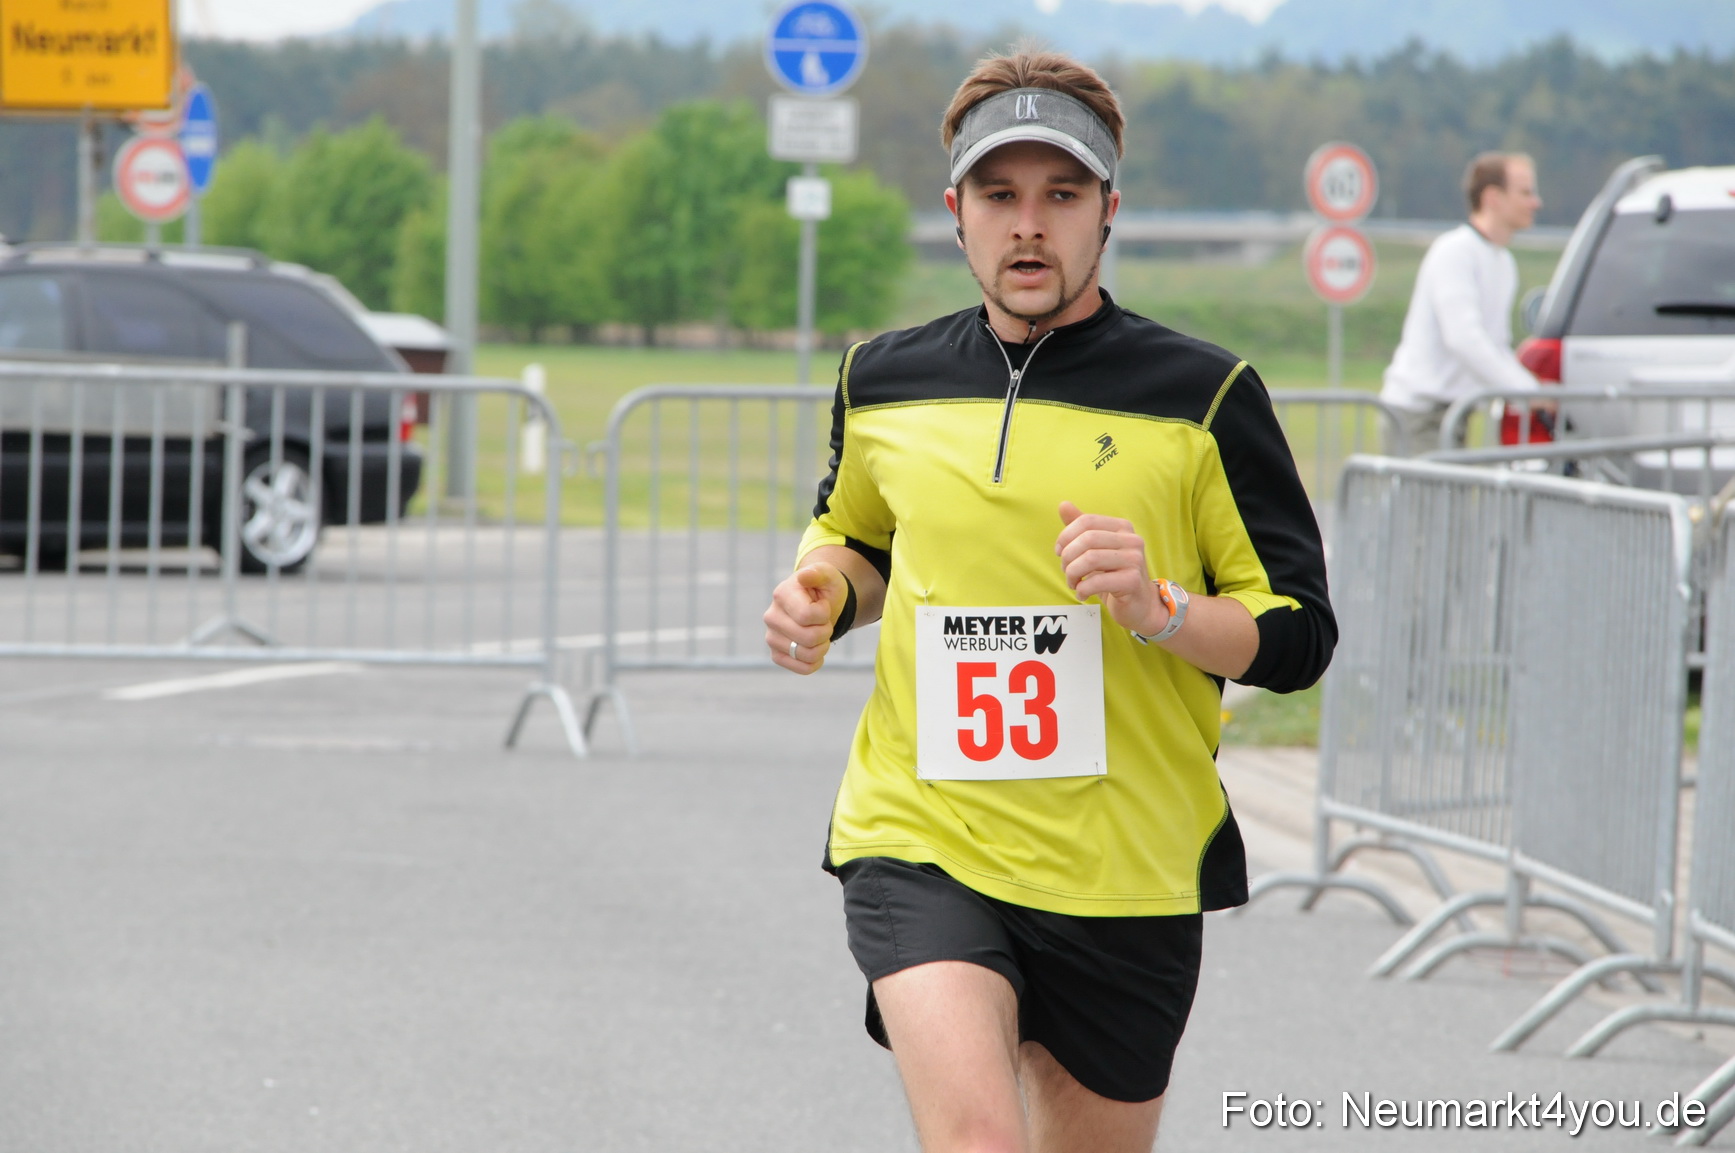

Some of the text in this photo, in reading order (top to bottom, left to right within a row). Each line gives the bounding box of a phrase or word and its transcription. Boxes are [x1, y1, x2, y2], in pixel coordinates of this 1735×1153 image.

[1015, 94, 1041, 120] CK
[943, 616, 1026, 636] MEYER
[944, 637, 1028, 651] WERBUNG
[956, 660, 1059, 762] 53
